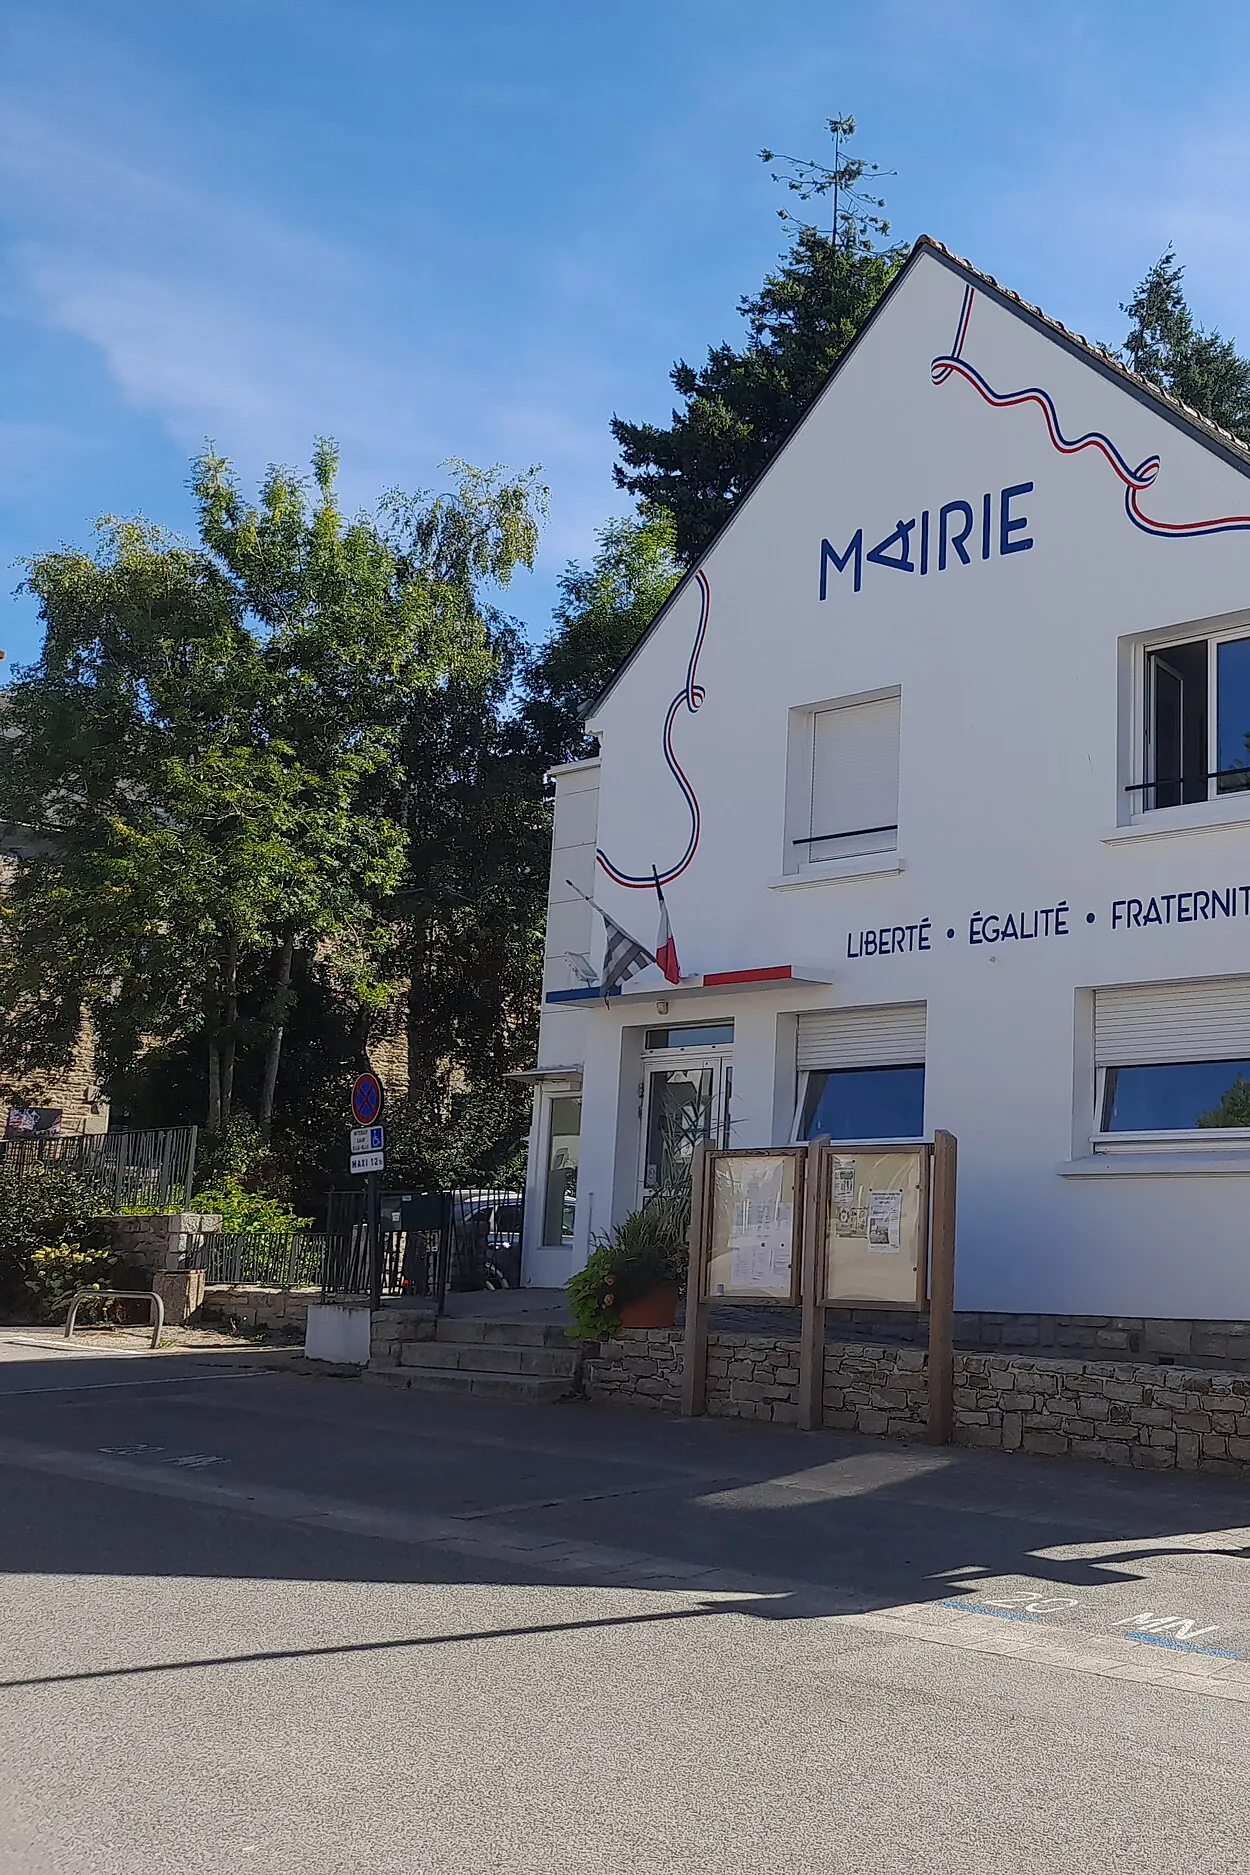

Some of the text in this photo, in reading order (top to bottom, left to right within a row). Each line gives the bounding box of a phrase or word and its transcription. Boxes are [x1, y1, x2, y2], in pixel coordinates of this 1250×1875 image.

[819, 481, 1034, 602] MAIRIE
[846, 916, 933, 959] LIBERTÉ
[968, 900, 1070, 945] ÉGALITÉ
[982, 1590, 1222, 1640] 20 MIN
